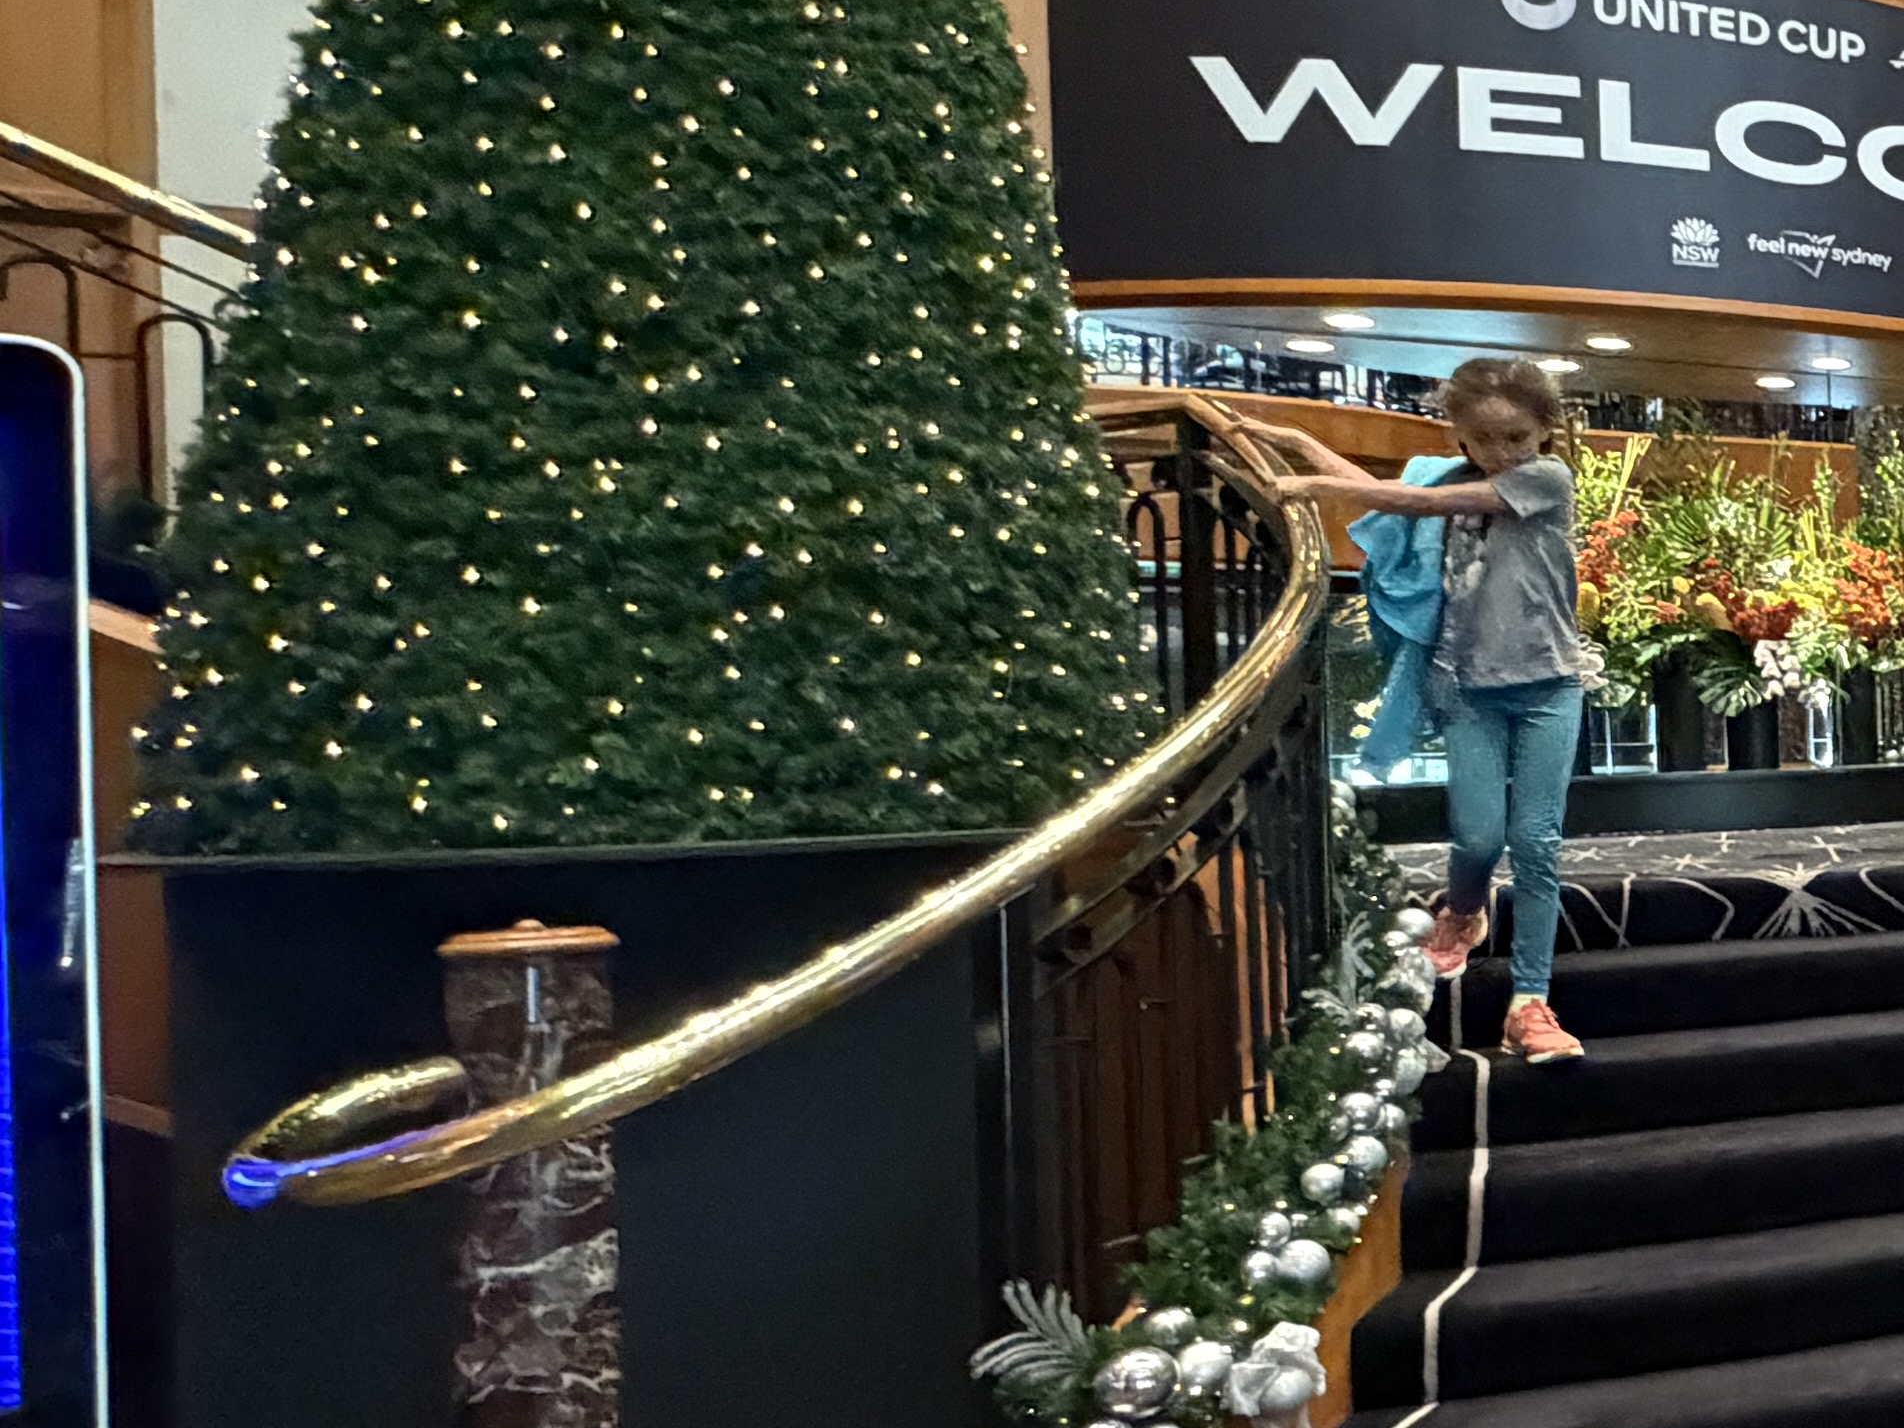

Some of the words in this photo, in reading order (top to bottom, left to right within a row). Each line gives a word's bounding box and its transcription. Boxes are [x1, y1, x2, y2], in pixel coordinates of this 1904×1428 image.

[1777, 19, 1867, 64] CUP
[1671, 243, 1720, 263] NSW
[1747, 233, 1786, 255] feel
[1787, 240, 1829, 260] new
[1831, 246, 1893, 273] sydney
